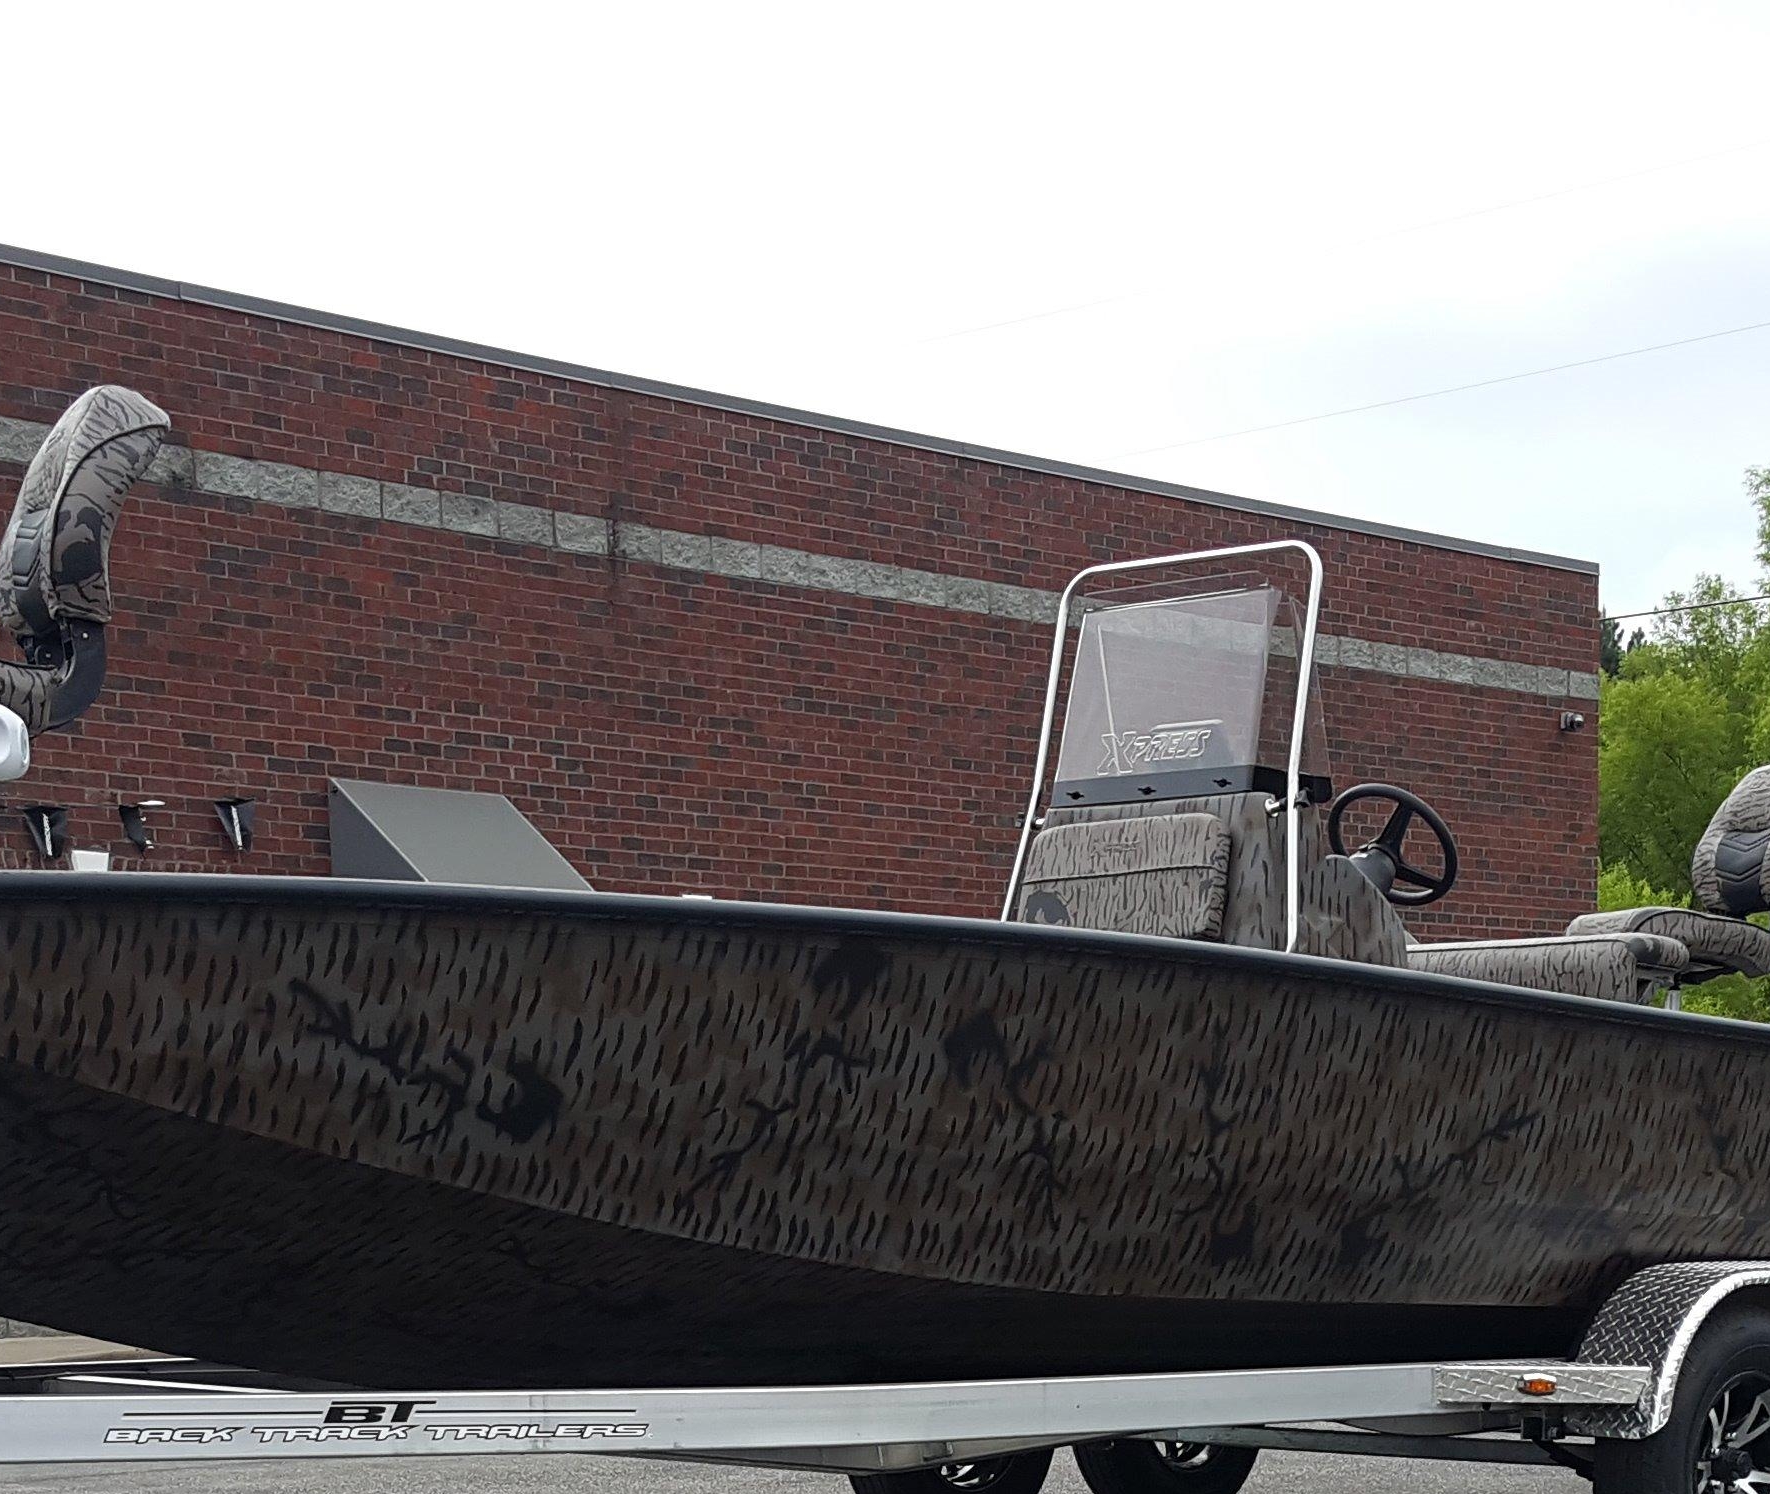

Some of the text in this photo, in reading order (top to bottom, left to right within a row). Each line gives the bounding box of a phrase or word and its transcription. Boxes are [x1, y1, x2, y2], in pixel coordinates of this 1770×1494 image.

[1096, 730, 1212, 776] XPRESS
[323, 1399, 437, 1425] BT
[103, 1423, 650, 1443] BACK TRACK TRAILERS
